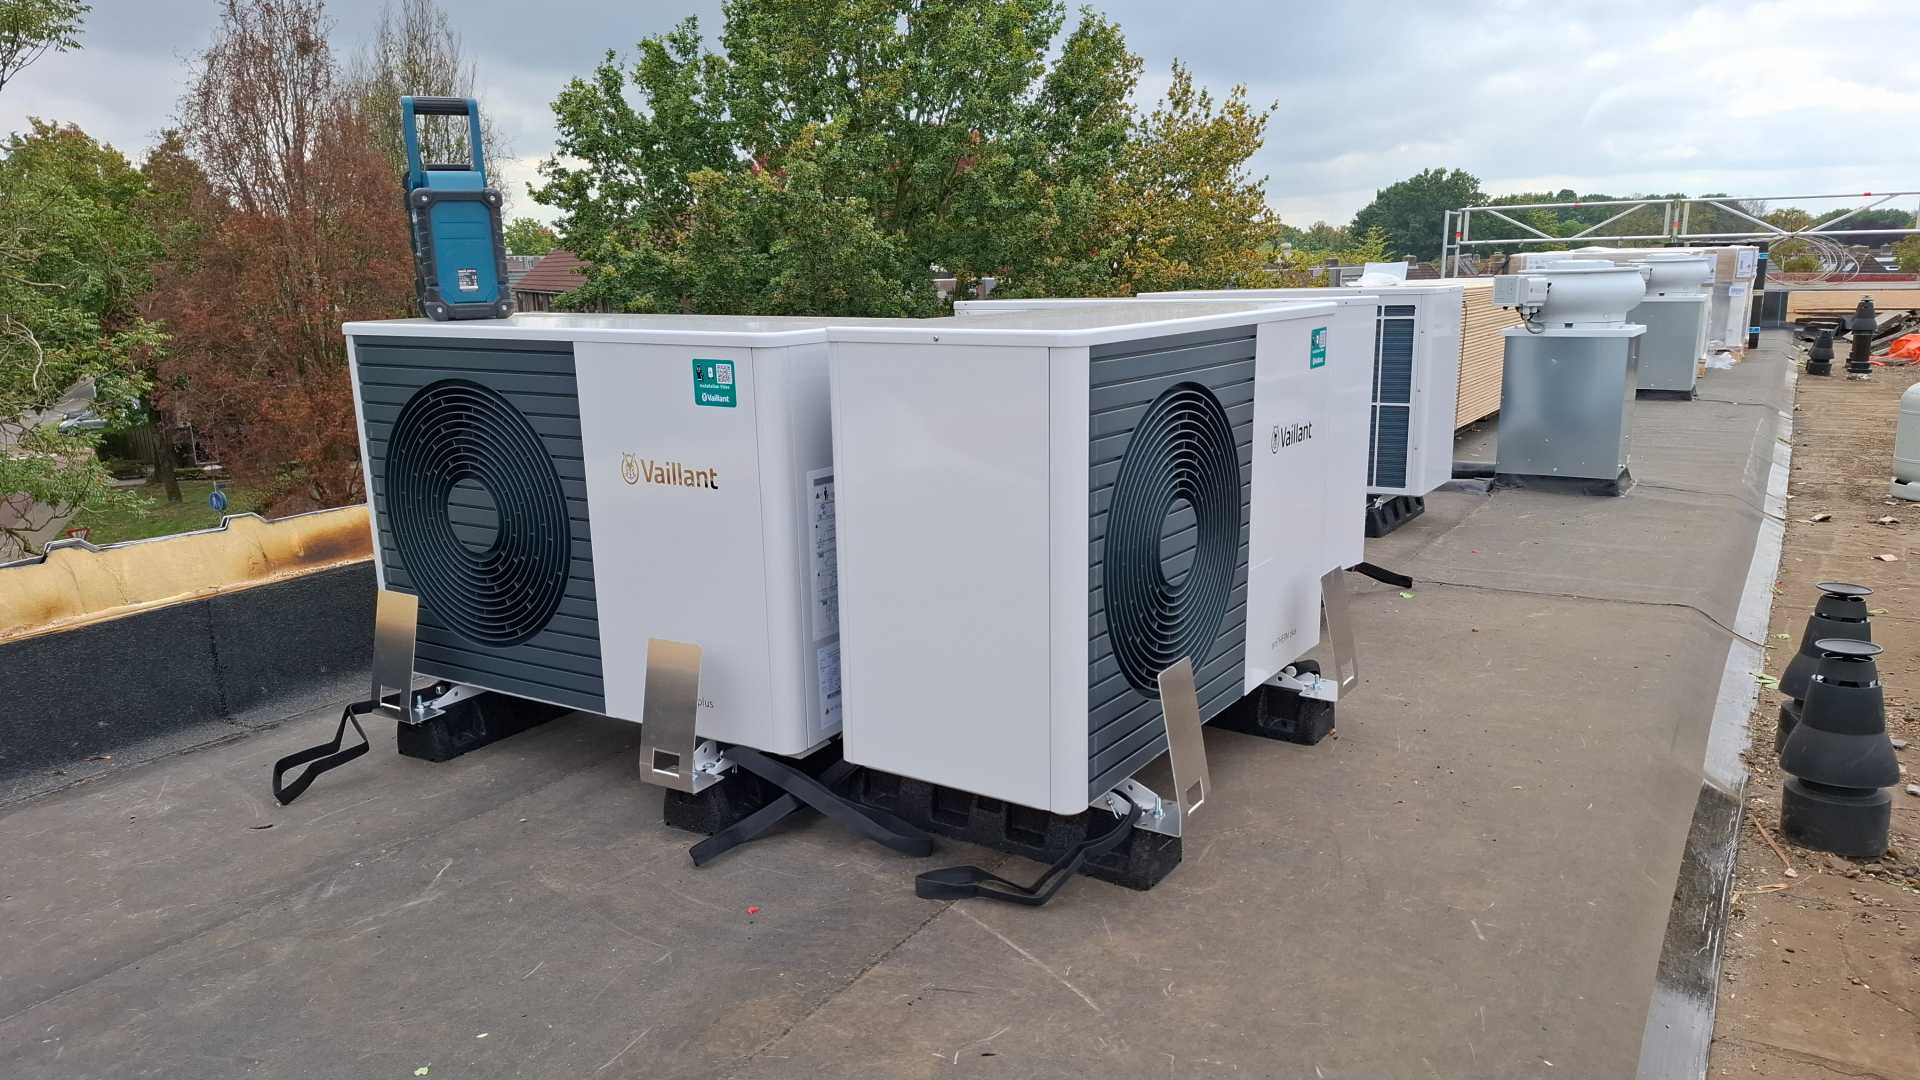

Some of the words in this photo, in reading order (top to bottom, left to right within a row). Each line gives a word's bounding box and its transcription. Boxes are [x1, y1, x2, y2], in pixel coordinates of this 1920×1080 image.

[706, 393, 729, 402] Vaillant
[1281, 421, 1312, 448] Vaillant
[640, 459, 719, 490] Vaillant
[698, 697, 714, 709] plus
